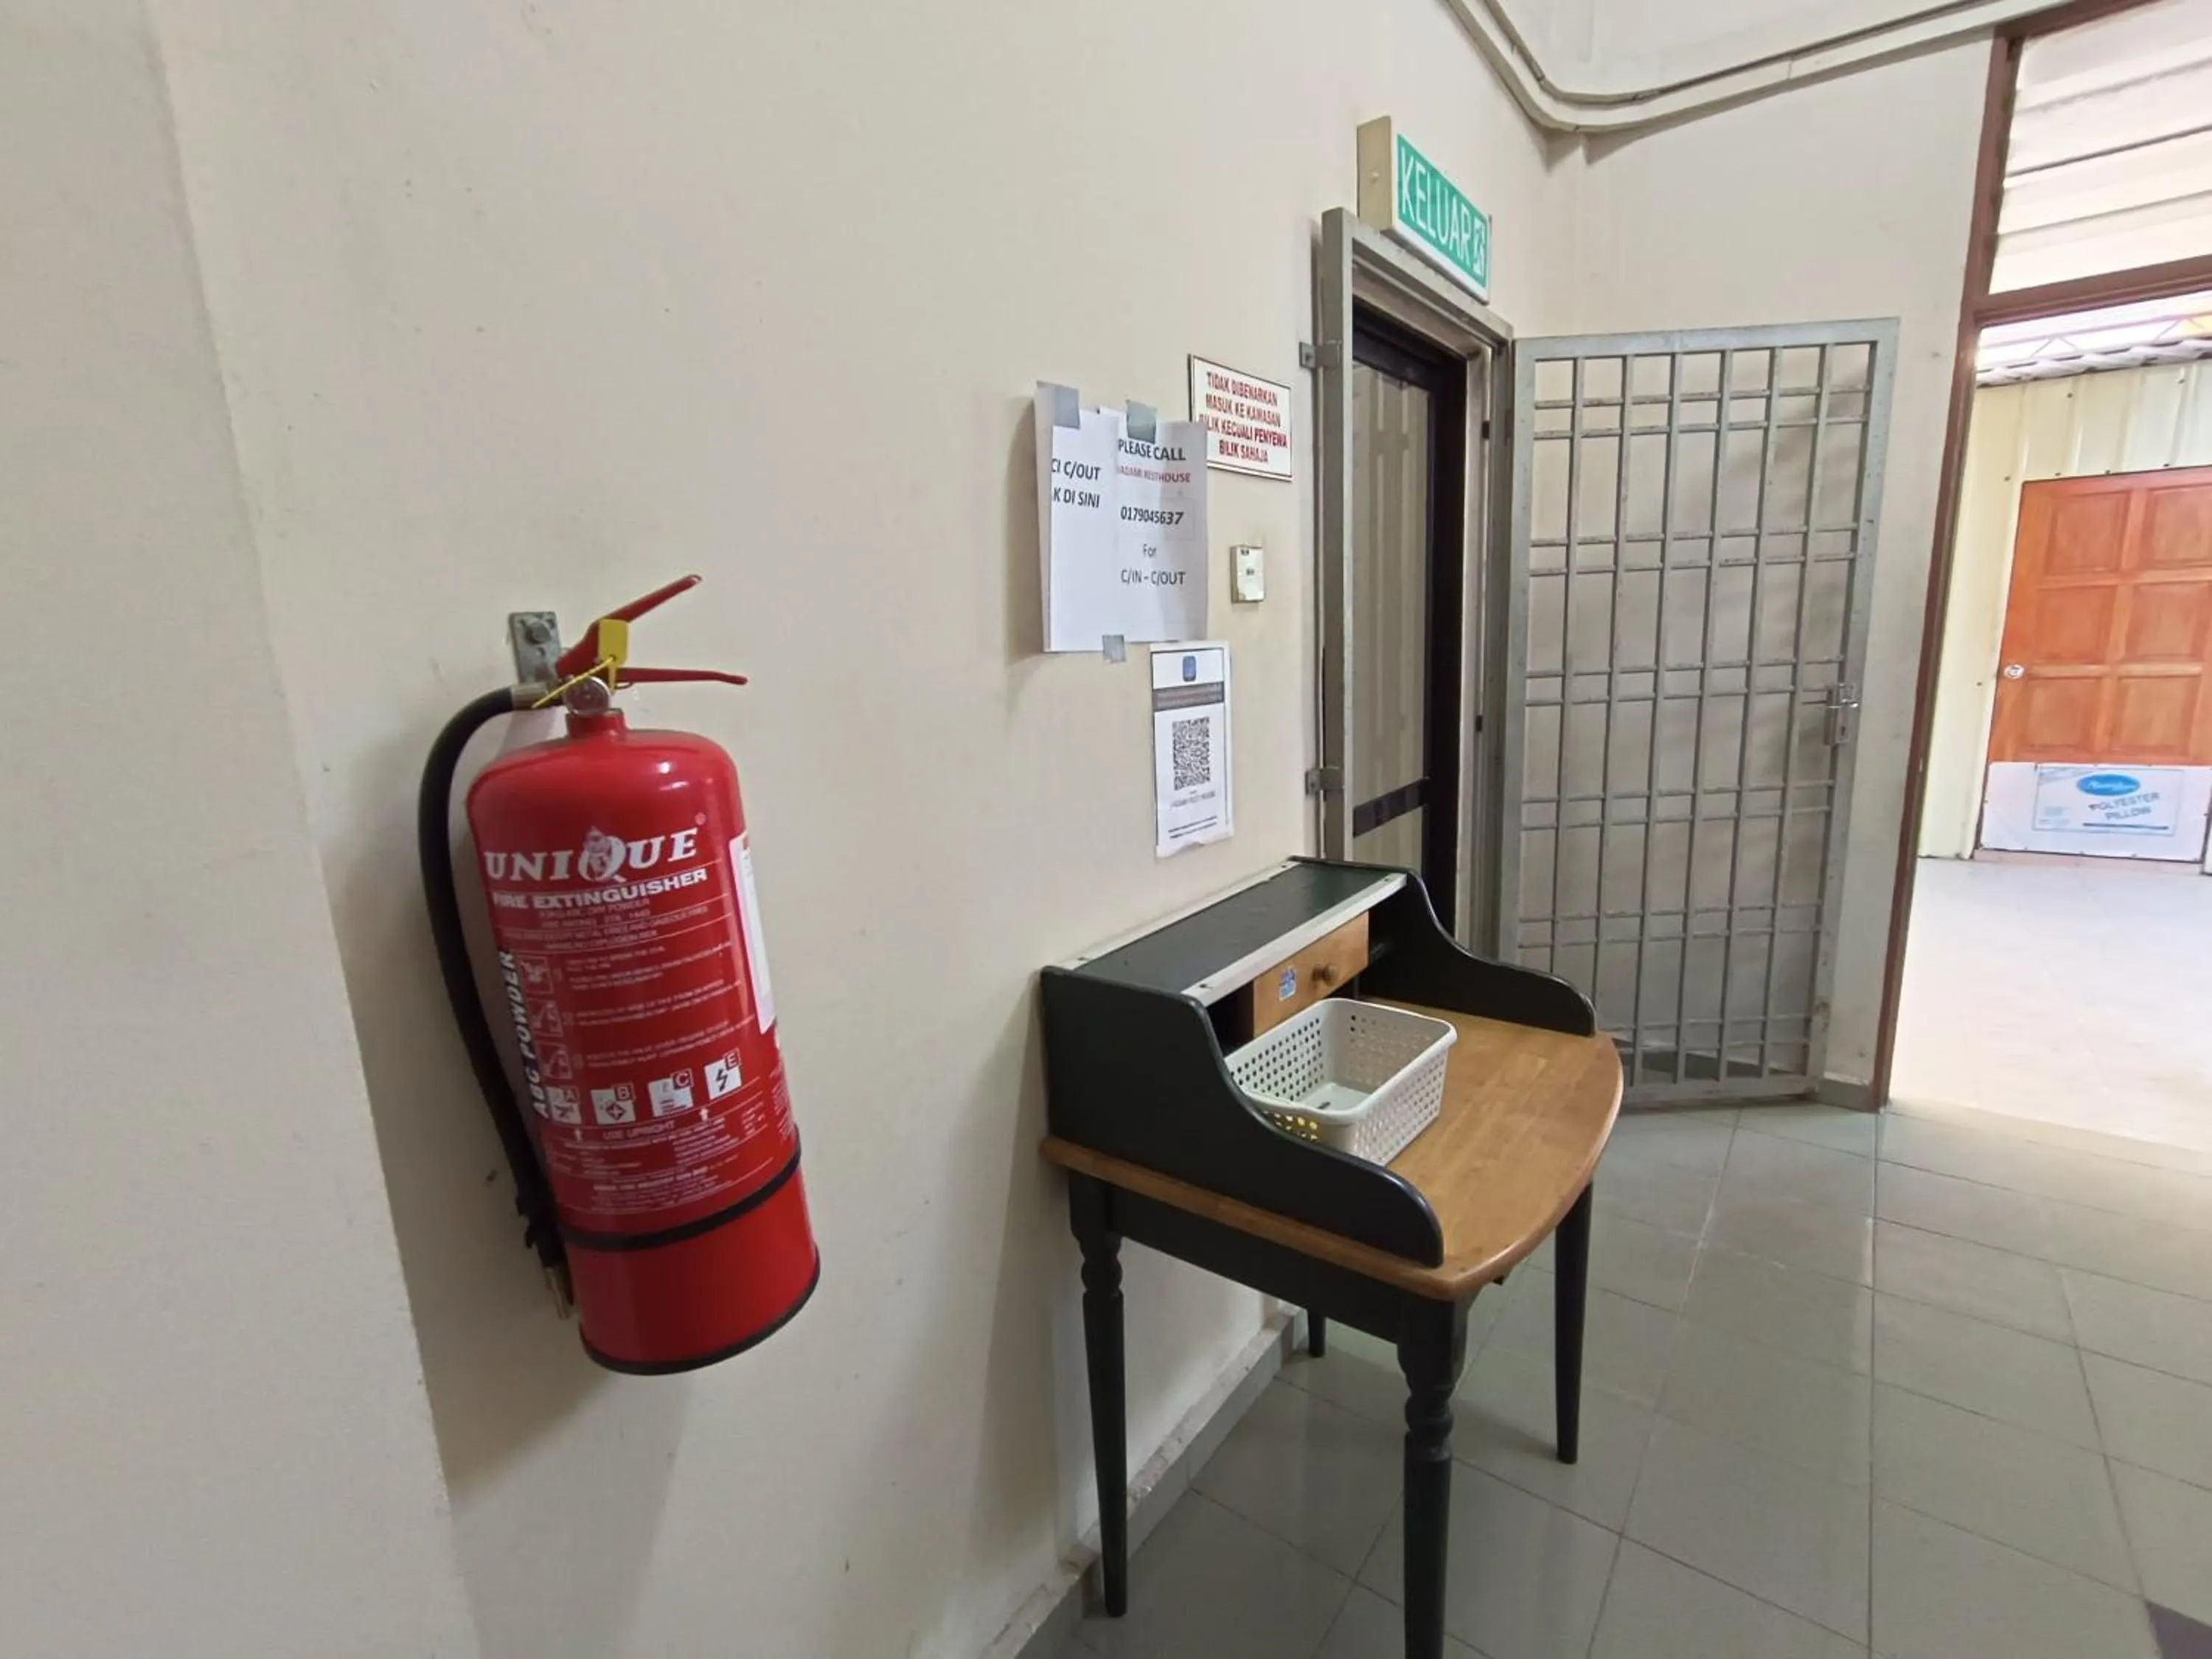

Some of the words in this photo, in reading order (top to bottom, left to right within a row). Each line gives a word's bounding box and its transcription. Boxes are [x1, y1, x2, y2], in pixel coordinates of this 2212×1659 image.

[1401, 146, 1472, 268] KELUAR
[1206, 372, 1231, 394] TIDAK
[1231, 380, 1278, 406] DIBENARKAN
[1206, 393, 1233, 414] MASUK
[1235, 403, 1245, 419] KE
[1247, 407, 1281, 428] KAWASAN
[1221, 419, 1253, 440] KECUALI
[1118, 438, 1152, 460] PLEASE
[1153, 447, 1186, 461] CALL
[1219, 439, 1239, 458] BILIK
[1241, 444, 1268, 463] SAHAJA
[1064, 461, 1102, 480] C/OUT
[1064, 489, 1075, 504] DI
[1078, 490, 1101, 508] SINI
[1120, 506, 1184, 526] 0179045637
[1143, 543, 1157, 557] For
[1120, 568, 1142, 584] C/IN
[1151, 571, 1186, 585] C/OUT
[484, 826, 698, 883] UNIQUE
[493, 891, 529, 909] FIRE
[532, 868, 708, 909] EXTINGUISHER
[499, 951, 536, 1060] POWDER
[526, 1068, 550, 1119] ABC
